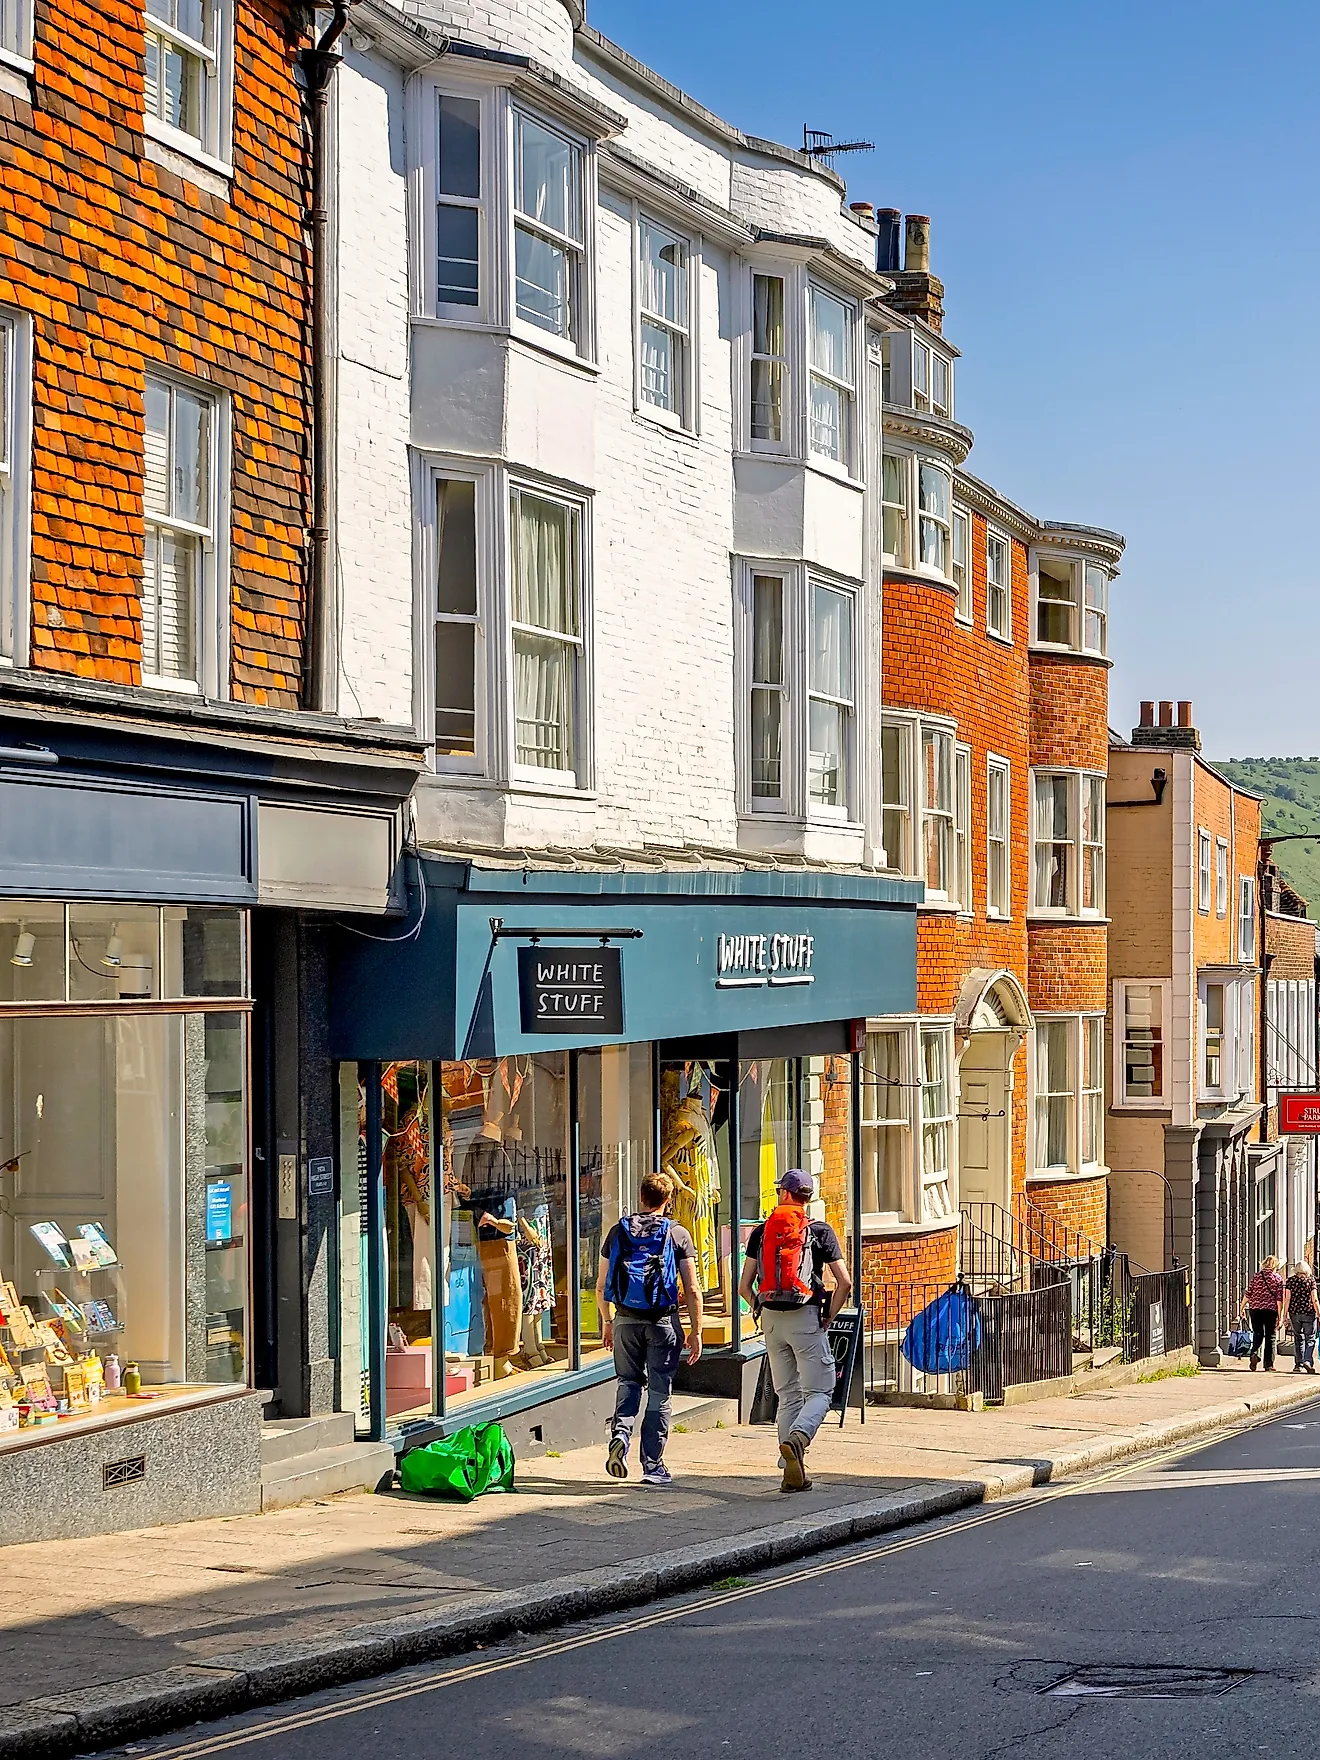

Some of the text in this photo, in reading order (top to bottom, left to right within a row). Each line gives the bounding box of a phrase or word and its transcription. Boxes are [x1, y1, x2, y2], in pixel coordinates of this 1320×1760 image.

[720, 933, 815, 972] WHITE STUFF
[537, 962, 604, 982] WHITE
[537, 993, 604, 1013] STUFF
